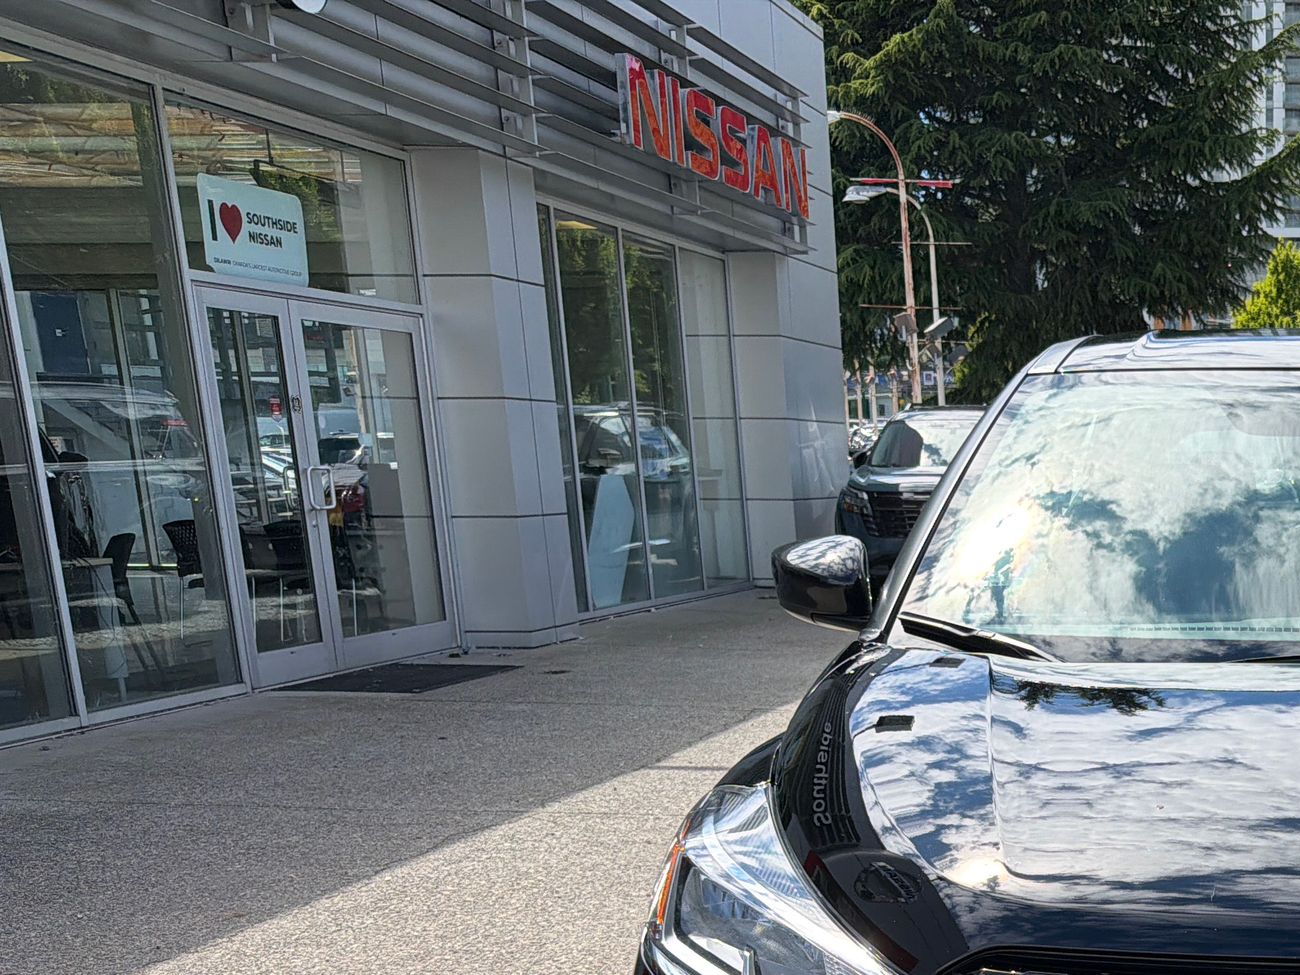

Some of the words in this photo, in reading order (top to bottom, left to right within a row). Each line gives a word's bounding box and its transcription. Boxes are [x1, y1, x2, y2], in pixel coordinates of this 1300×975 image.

[618, 53, 810, 219] NISSAN
[246, 212, 298, 234] SOUTHSIDE
[248, 230, 282, 248] NISSAN
